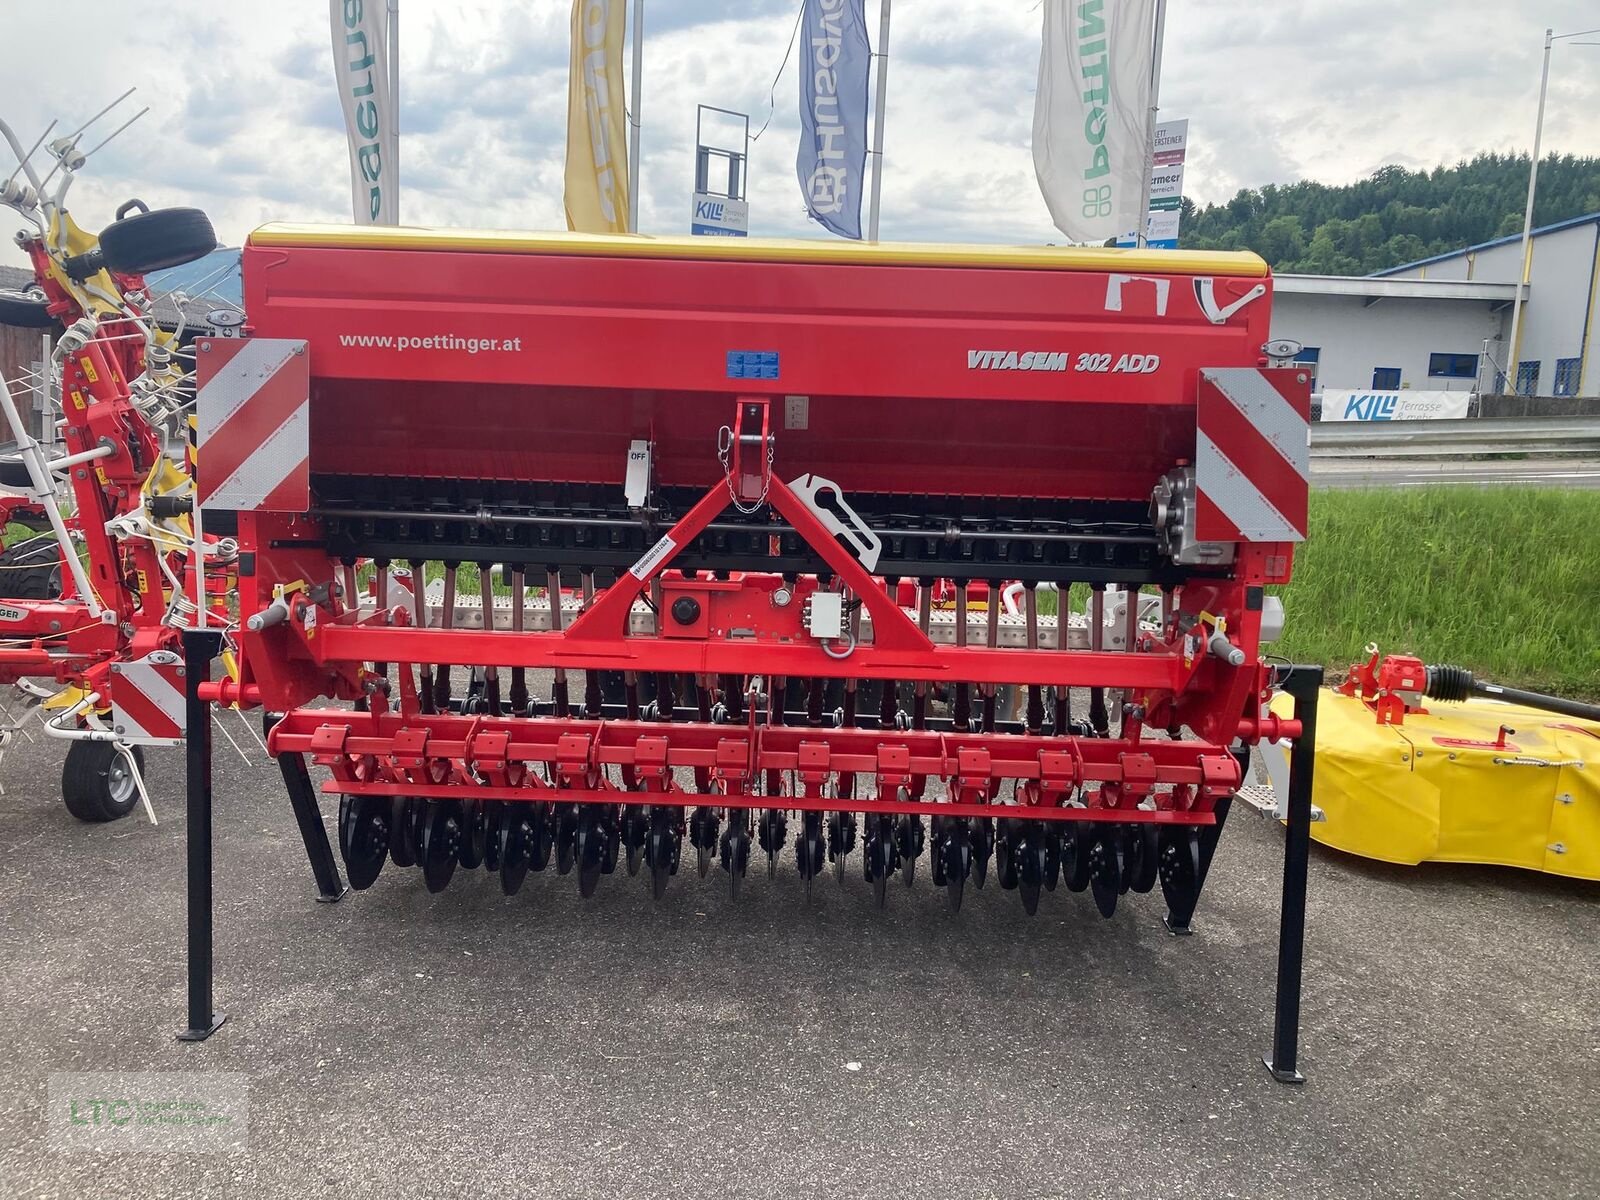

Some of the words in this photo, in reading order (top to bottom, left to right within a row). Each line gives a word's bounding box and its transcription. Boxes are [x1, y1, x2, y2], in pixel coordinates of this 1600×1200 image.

[339, 334, 521, 353] www.poettinger.at
[967, 350, 1069, 372] VITASEM
[1074, 352, 1112, 373] 302
[1112, 354, 1161, 374] ADD
[1401, 400, 1442, 412] Terrasse
[631, 452, 646, 461] OFF
[0, 609, 19, 619] GER
